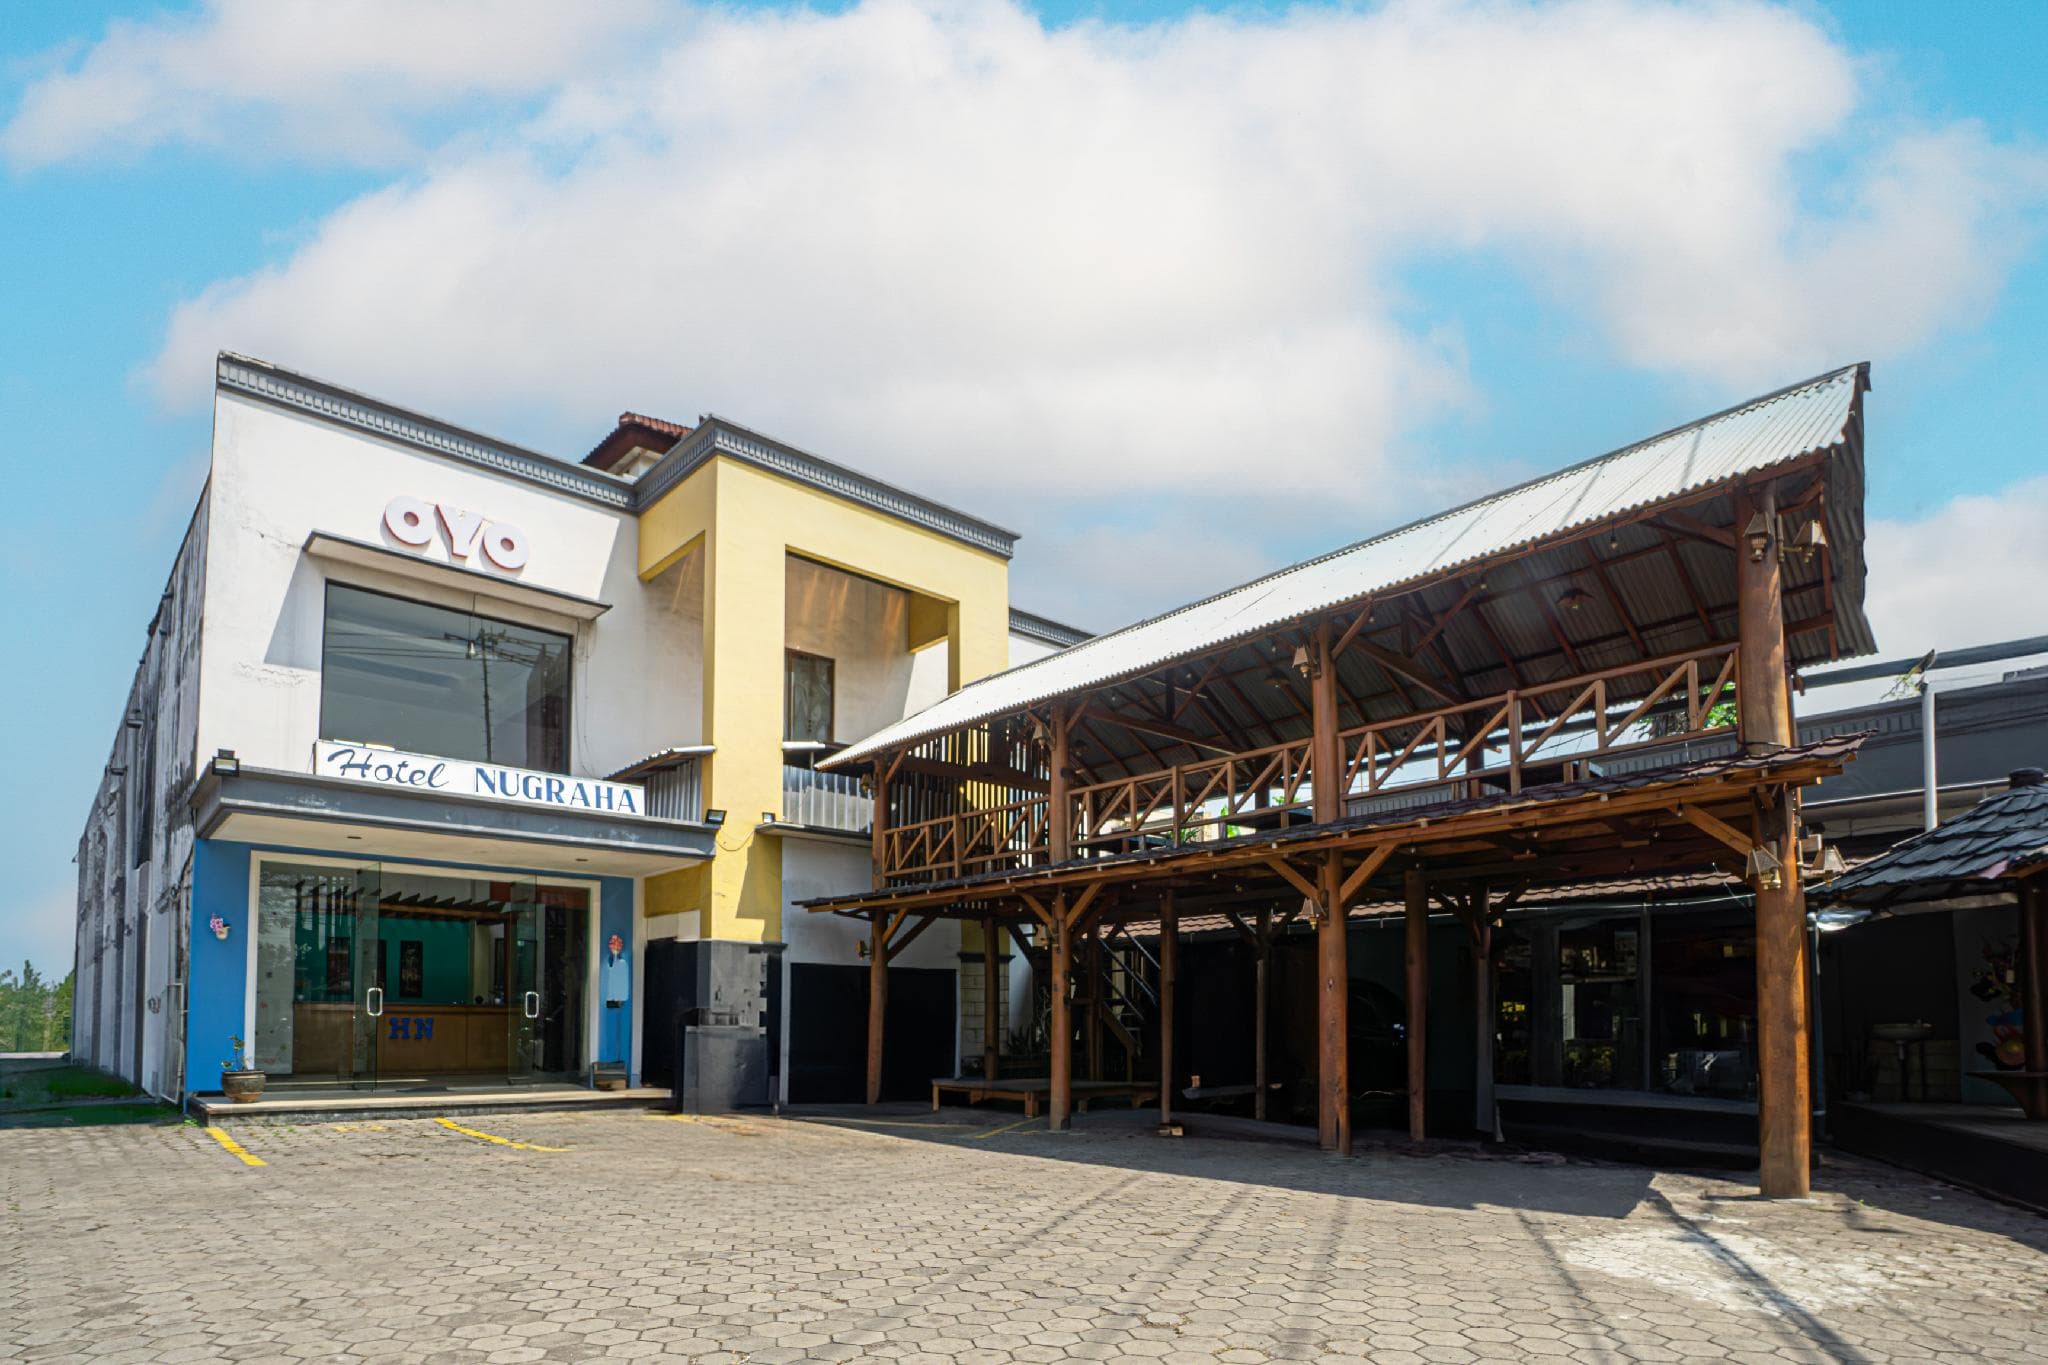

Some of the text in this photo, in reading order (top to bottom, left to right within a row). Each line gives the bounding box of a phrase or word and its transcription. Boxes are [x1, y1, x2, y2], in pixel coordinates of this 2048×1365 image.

[384, 495, 530, 569] OYO
[327, 748, 637, 813] Hotel NUGRAHA
[389, 1016, 433, 1040] HN
